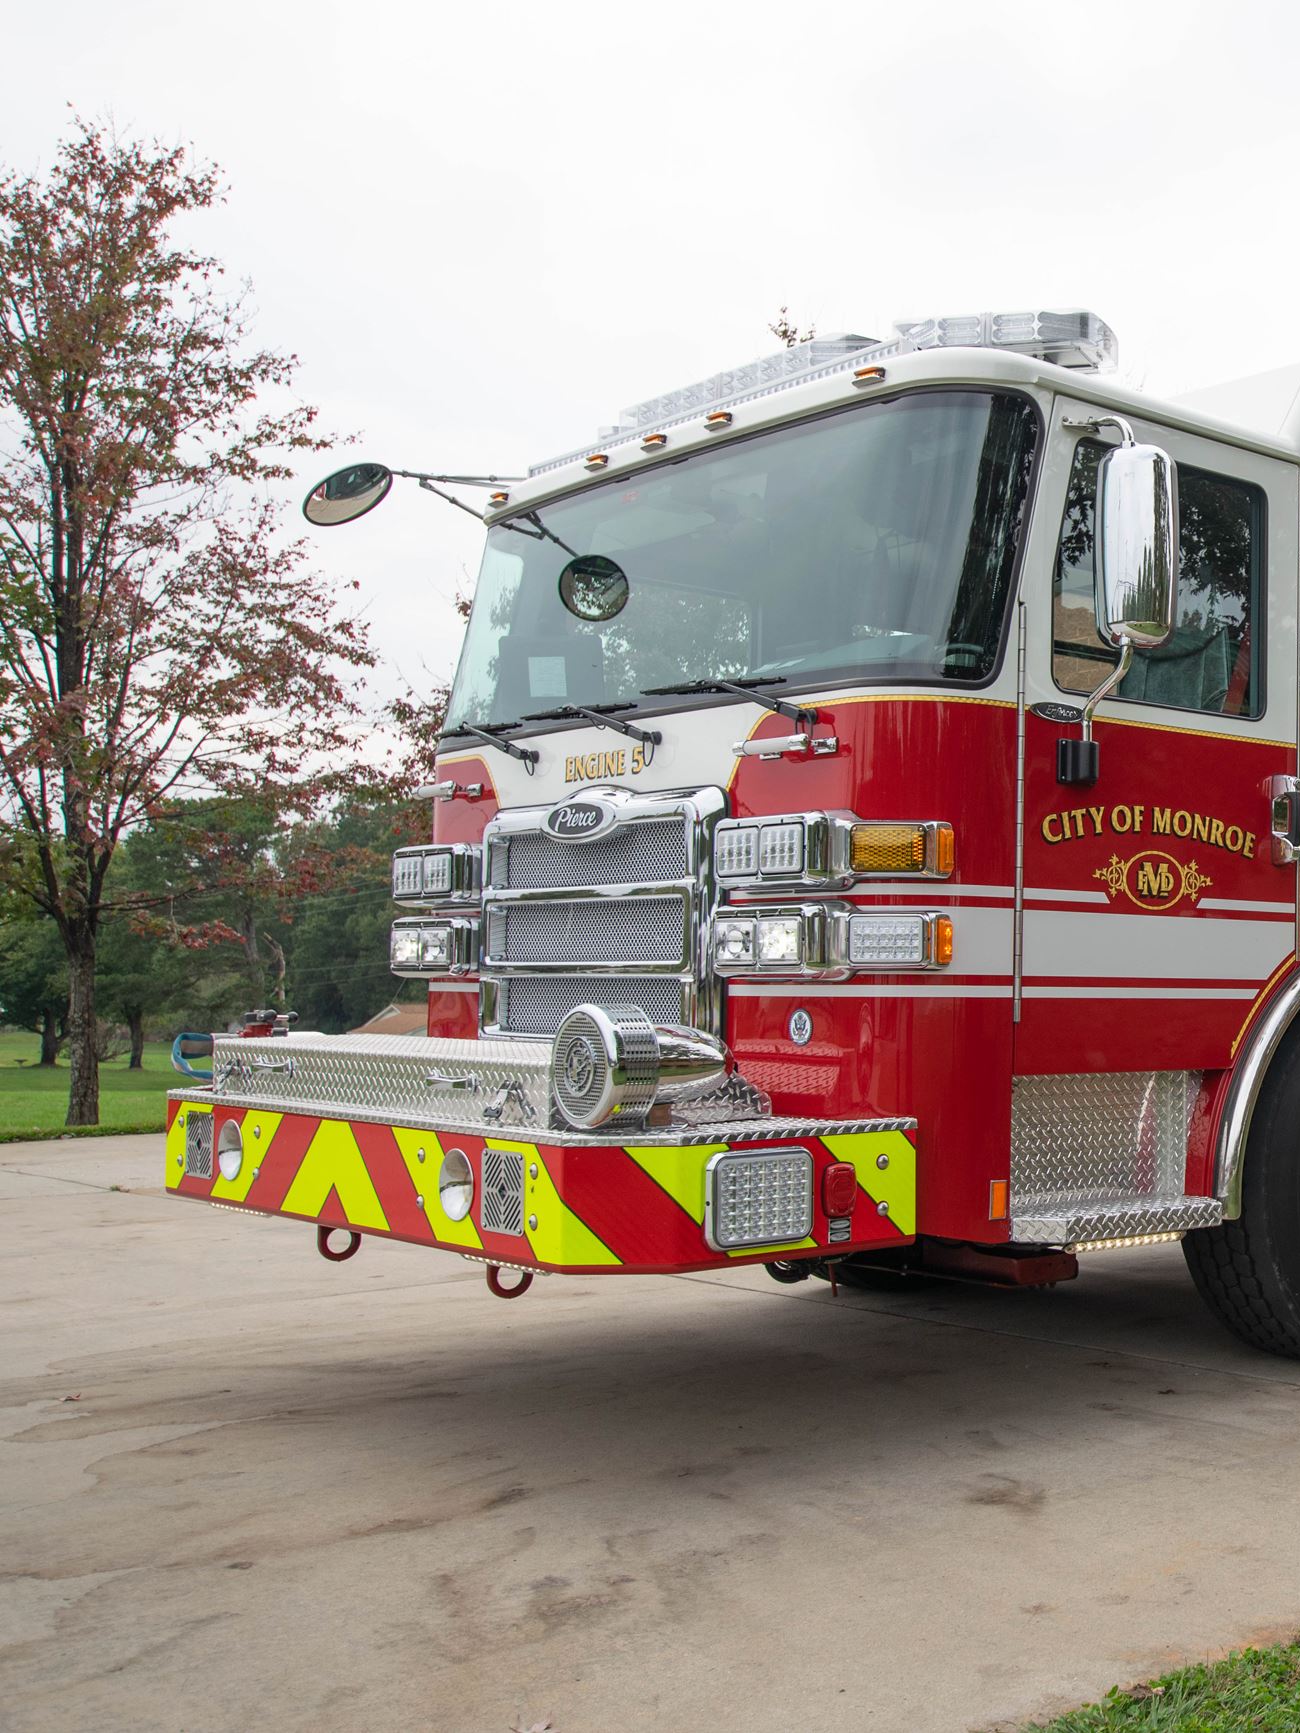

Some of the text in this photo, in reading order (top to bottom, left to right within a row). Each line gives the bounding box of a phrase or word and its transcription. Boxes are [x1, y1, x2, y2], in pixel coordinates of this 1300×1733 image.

[565, 745, 645, 783] ENGINE 5
[554, 806, 598, 833] Pierce
[1041, 805, 1256, 859] CITY OF MONROE
